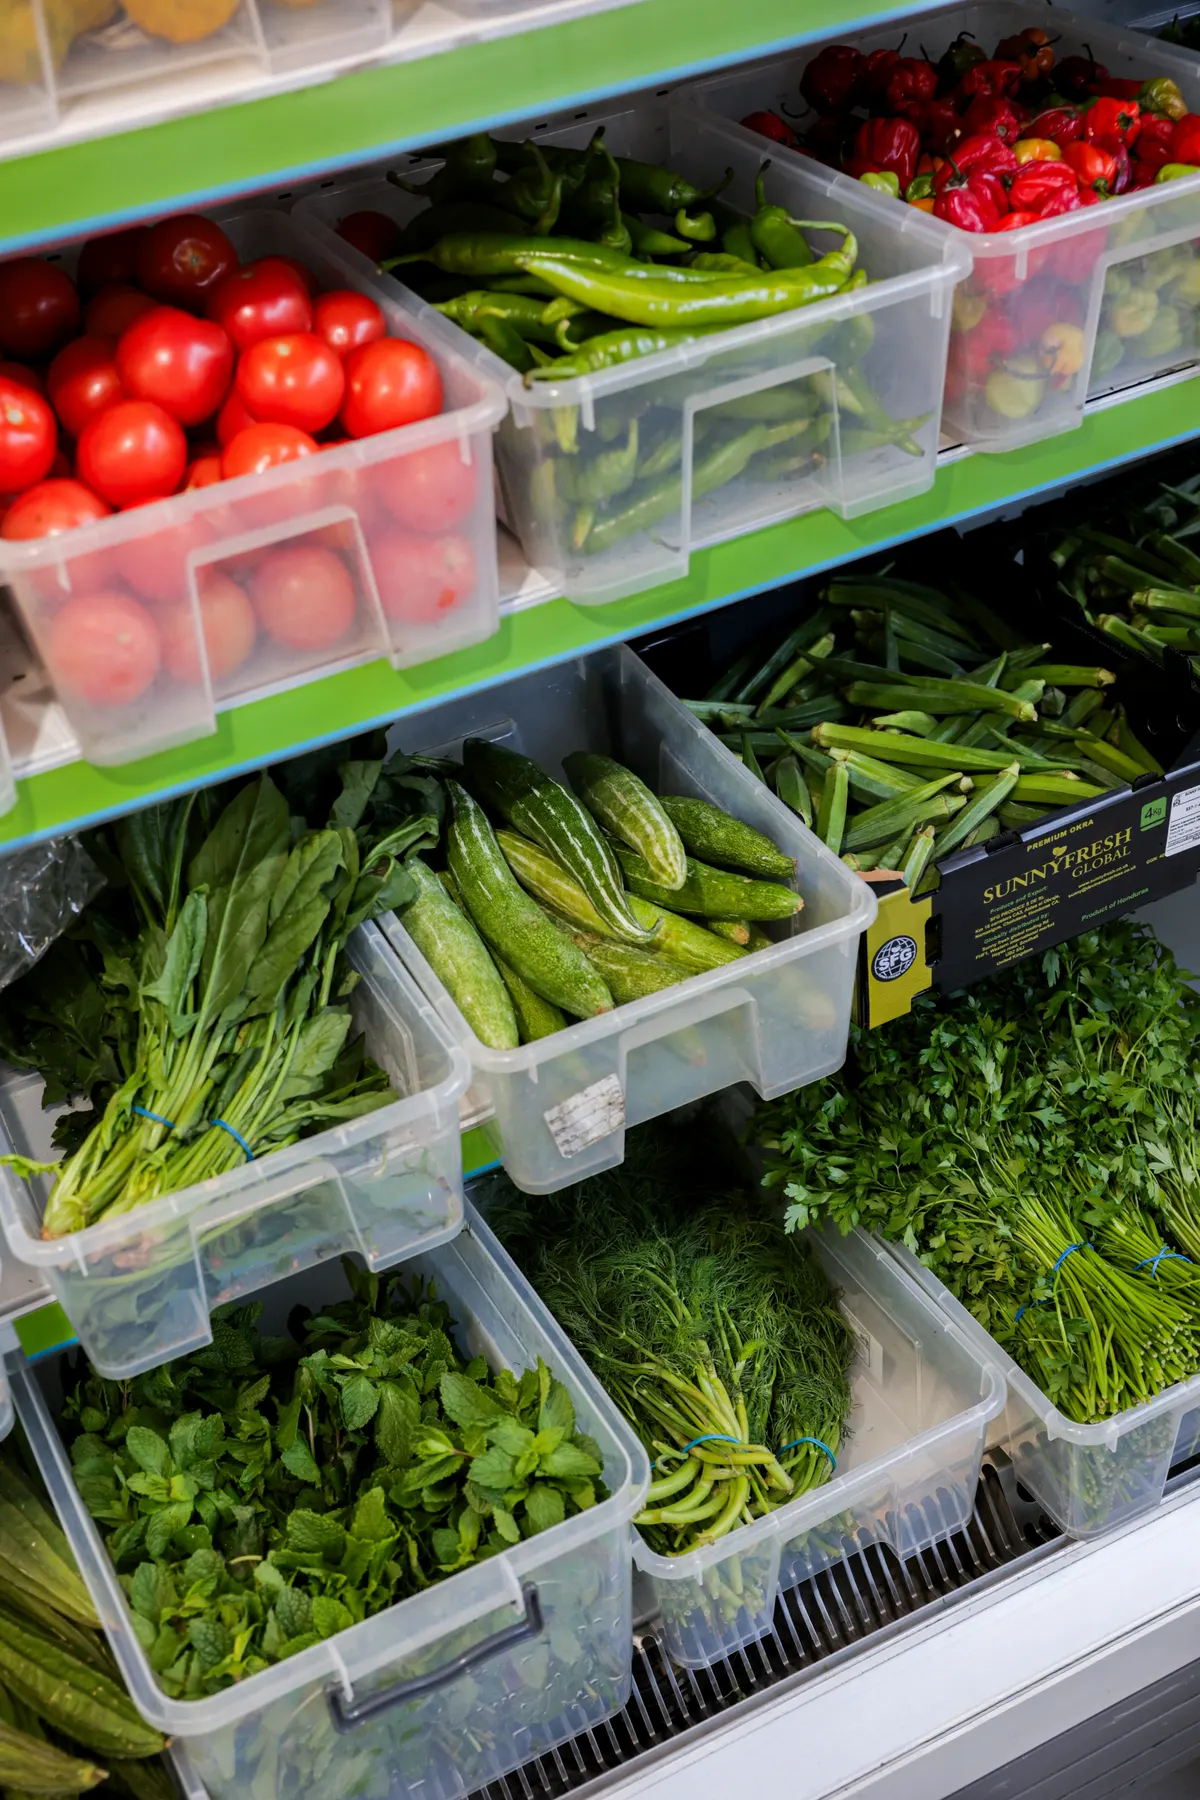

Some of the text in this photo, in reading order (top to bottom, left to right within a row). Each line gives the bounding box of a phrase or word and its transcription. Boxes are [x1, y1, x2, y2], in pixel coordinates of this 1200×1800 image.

[1027, 819, 1094, 852] PREMIUM OKRA
[983, 826, 1132, 904] SUNNYFRESH
[1072, 846, 1131, 878] GLOBAL
[990, 886, 1048, 914] Produce and Export:
[1001, 904, 1025, 917] PRODUCE
[1028, 904, 1050, 916] Honduras
[1082, 888, 1149, 921] Product of Honduras
[982, 943, 997, 952] Sunny
[1010, 930, 1025, 940] global
[984, 931, 1007, 944] Globally
[1009, 917, 1039, 933] distributed
[990, 942, 1009, 953] Western
[1039, 922, 1055, 932] market
[879, 948, 912, 970] SFG
[996, 947, 1033, 966] United Kingdom
